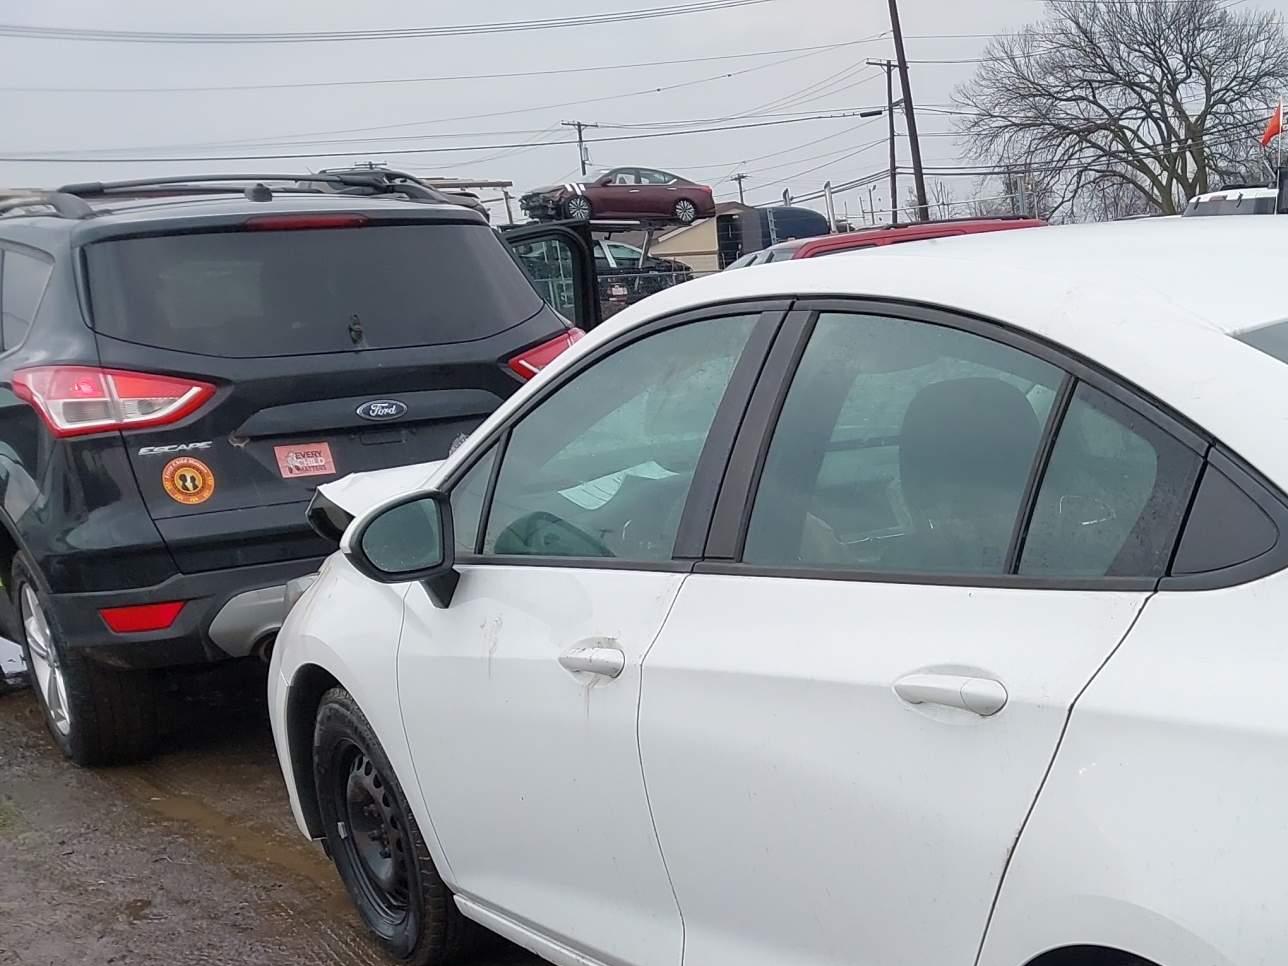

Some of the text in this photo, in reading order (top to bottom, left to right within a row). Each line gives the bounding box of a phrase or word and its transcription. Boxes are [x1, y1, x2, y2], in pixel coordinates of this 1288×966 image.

[369, 403, 397, 417] Ford
[138, 440, 213, 456] ESCAPE
[294, 450, 322, 460] EVERY
